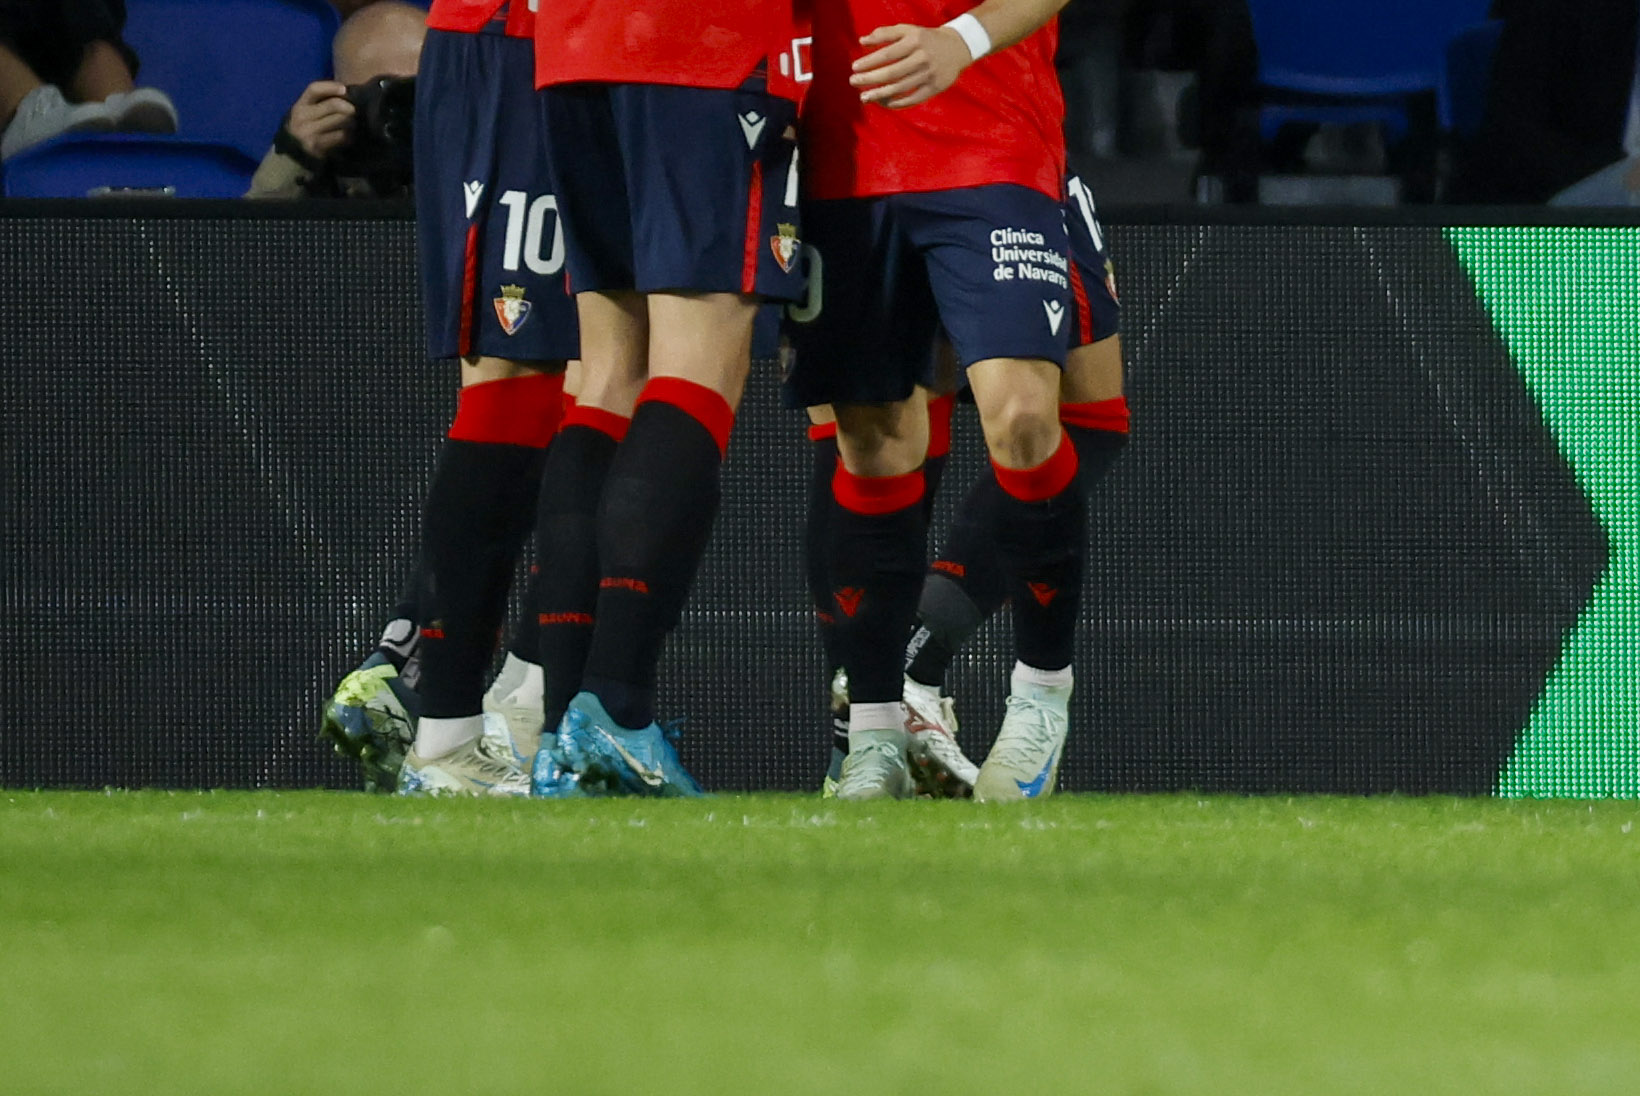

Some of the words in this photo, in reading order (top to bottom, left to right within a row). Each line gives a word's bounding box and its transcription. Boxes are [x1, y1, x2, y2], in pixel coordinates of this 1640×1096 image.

[498, 189, 566, 276] 10
[990, 226, 1045, 247] Clínica
[993, 264, 1015, 282] de
